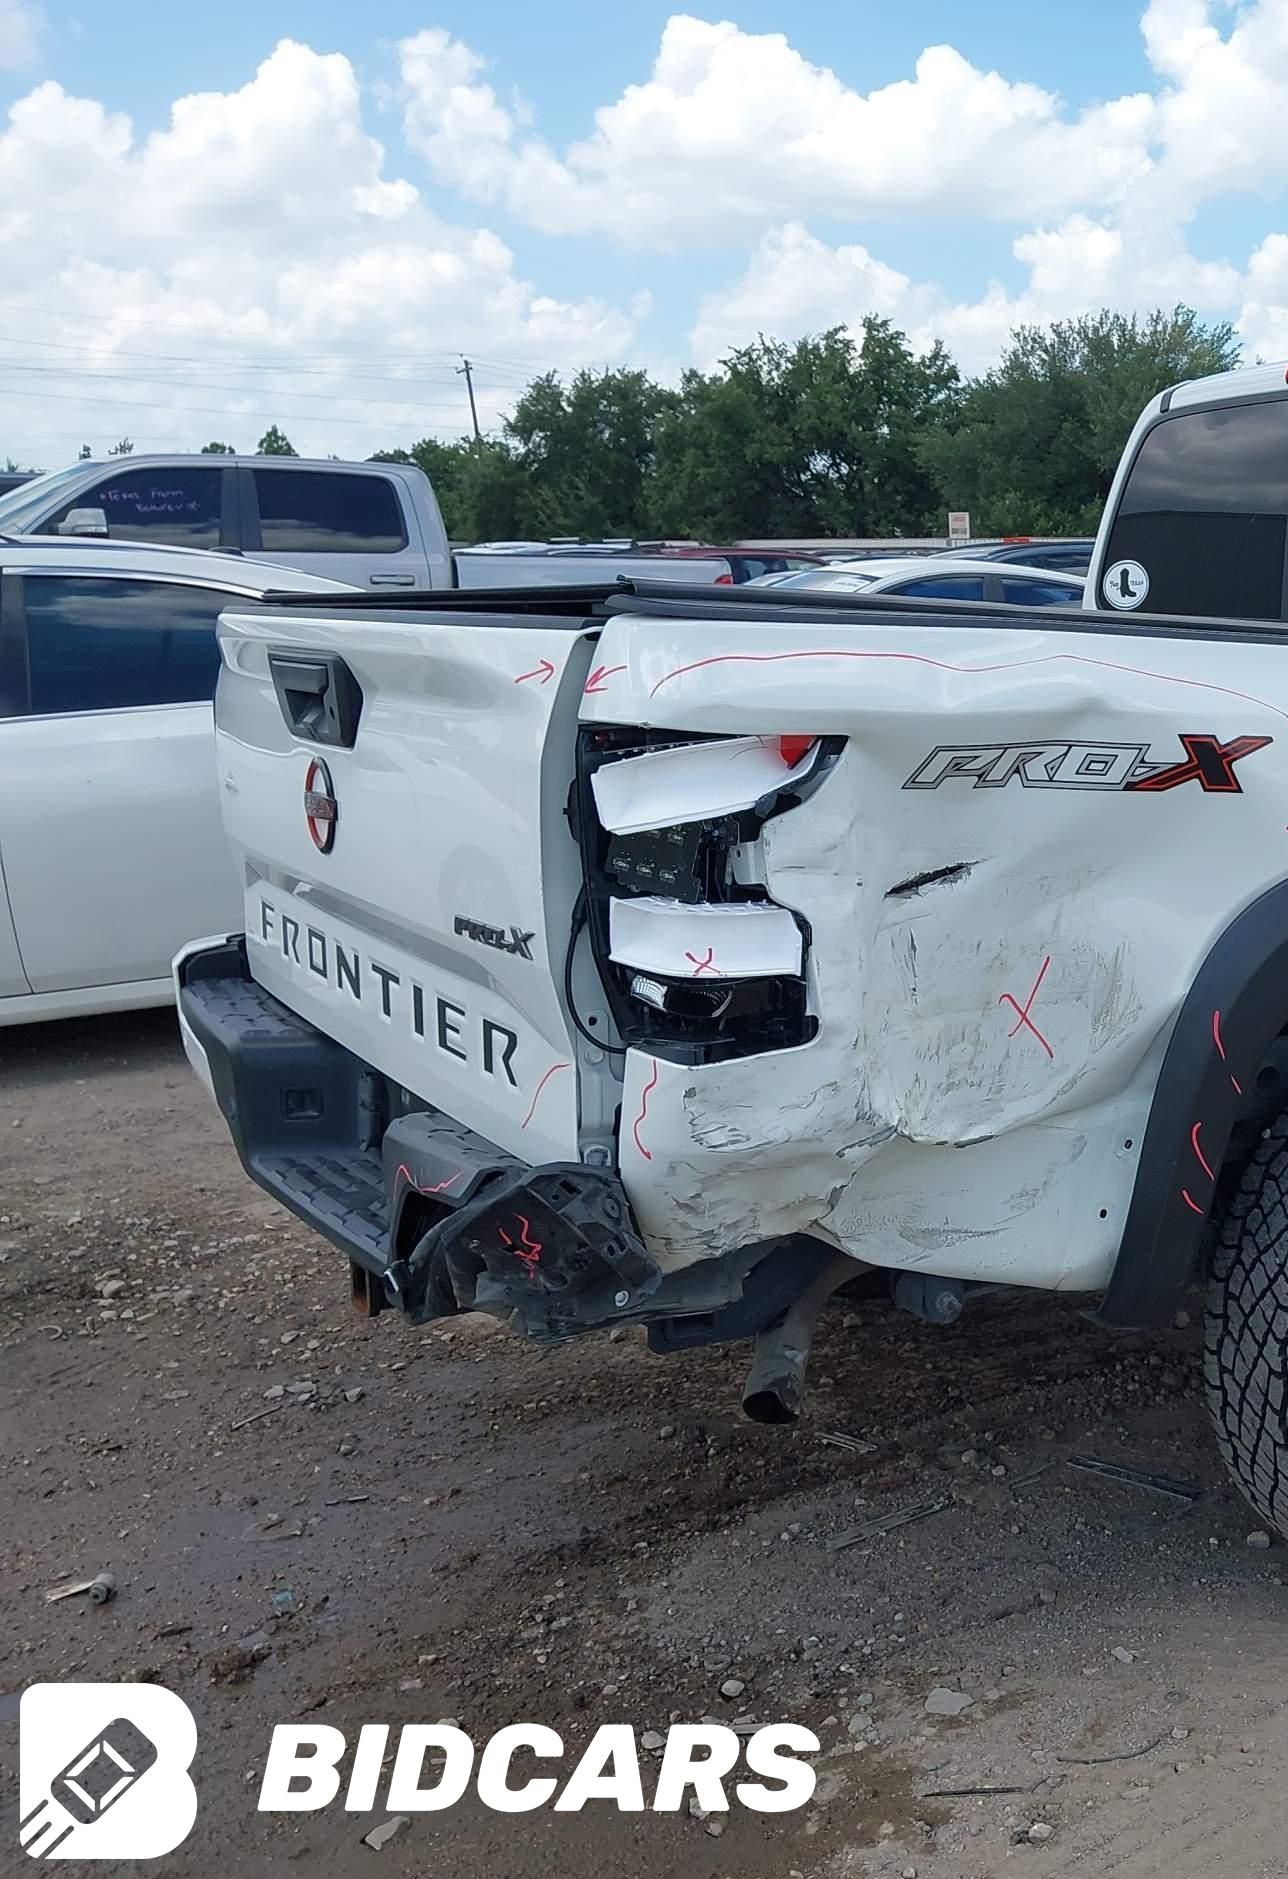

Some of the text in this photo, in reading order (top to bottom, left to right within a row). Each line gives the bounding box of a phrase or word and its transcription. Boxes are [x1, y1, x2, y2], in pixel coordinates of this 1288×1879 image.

[901, 733, 1274, 793] PRO-X
[454, 913, 537, 961] PRO-X
[260, 899, 520, 1089] FRONTIER
